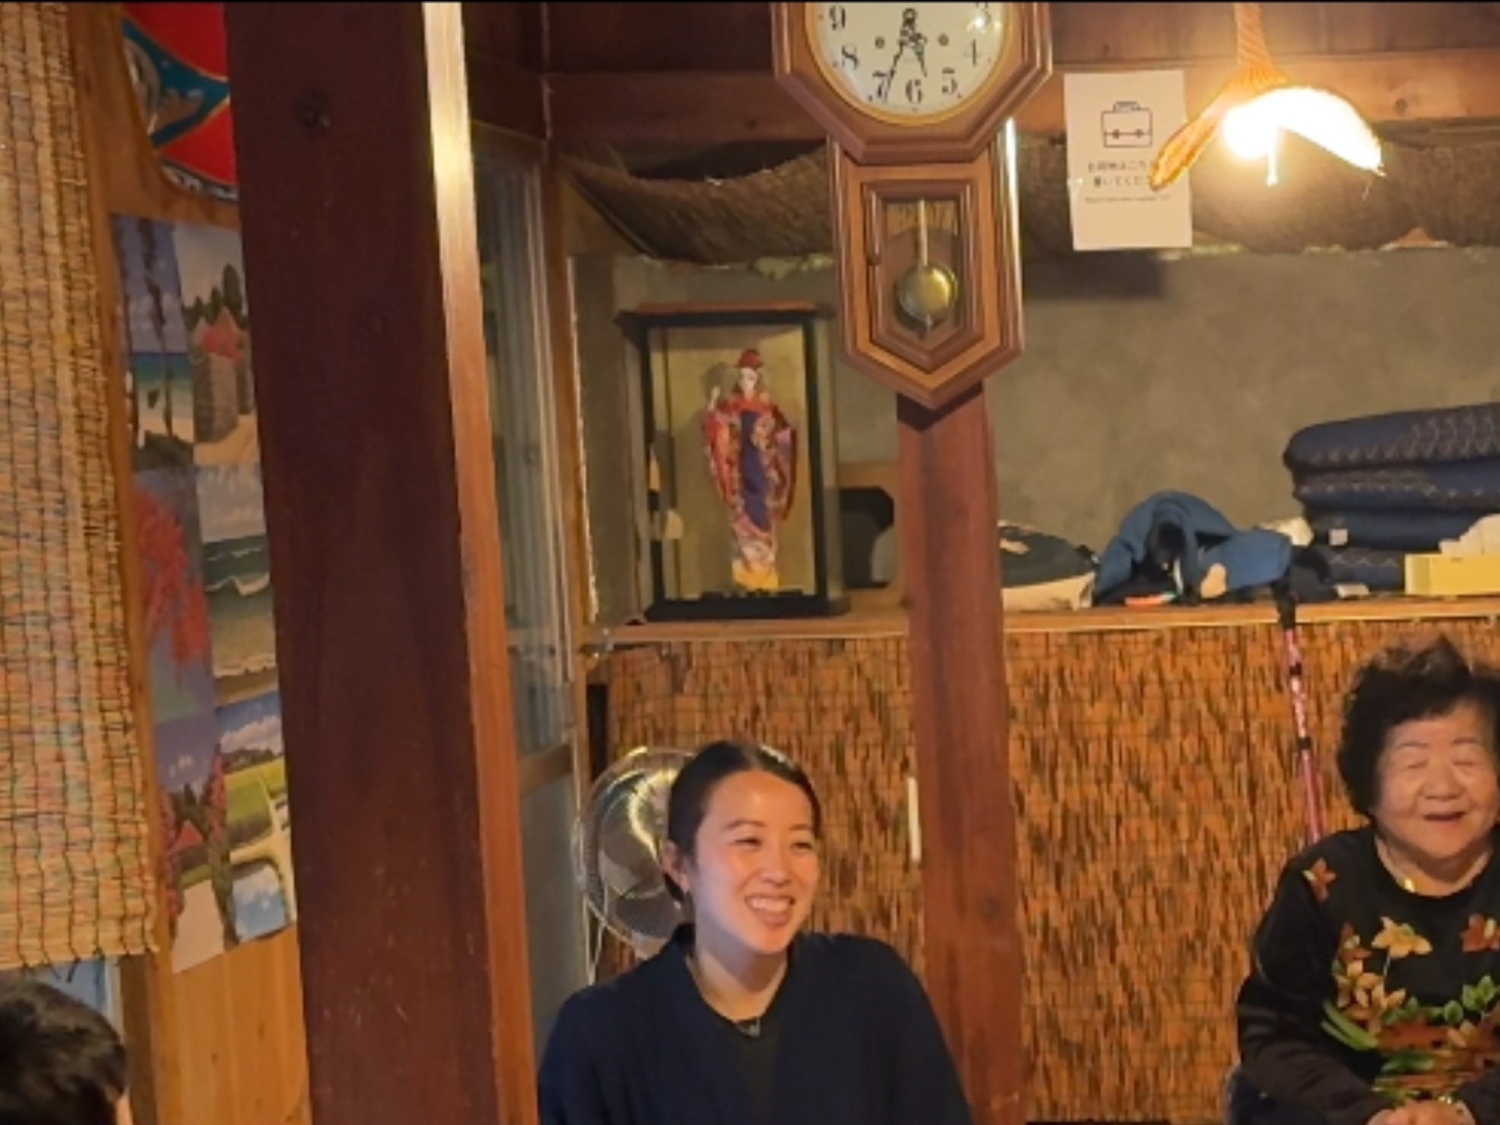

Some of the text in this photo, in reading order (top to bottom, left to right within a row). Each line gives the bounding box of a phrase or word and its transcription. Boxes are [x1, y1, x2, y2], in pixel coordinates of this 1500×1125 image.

[828, 5, 846, 30] 9
[841, 44, 859, 70] 8
[963, 38, 981, 68] 4
[872, 70, 889, 99] 7
[905, 78, 923, 104] 6
[941, 66, 959, 95] 5
